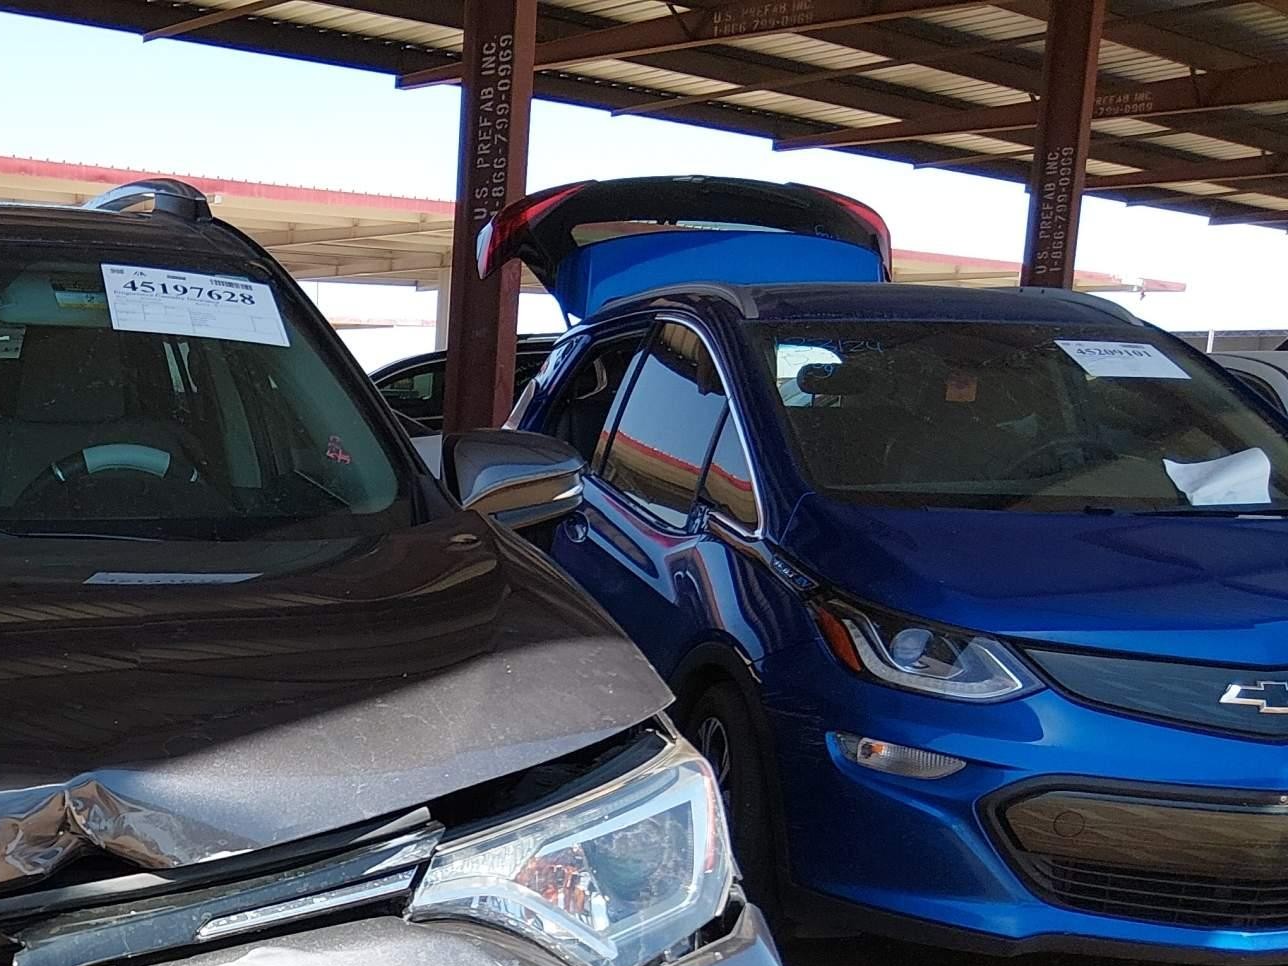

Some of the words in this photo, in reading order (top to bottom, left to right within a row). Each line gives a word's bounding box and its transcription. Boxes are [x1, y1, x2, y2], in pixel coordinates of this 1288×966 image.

[482, 35, 497, 75] INC.
[477, 86, 495, 169] PREFAB
[490, 34, 512, 217] 1-866-799-0969
[1046, 146, 1060, 175] INC.
[474, 180, 489, 220] U.S.
[1039, 182, 1056, 239] PREFAB
[1035, 246, 1050, 274] U.S.
[122, 279, 256, 305] 45197628
